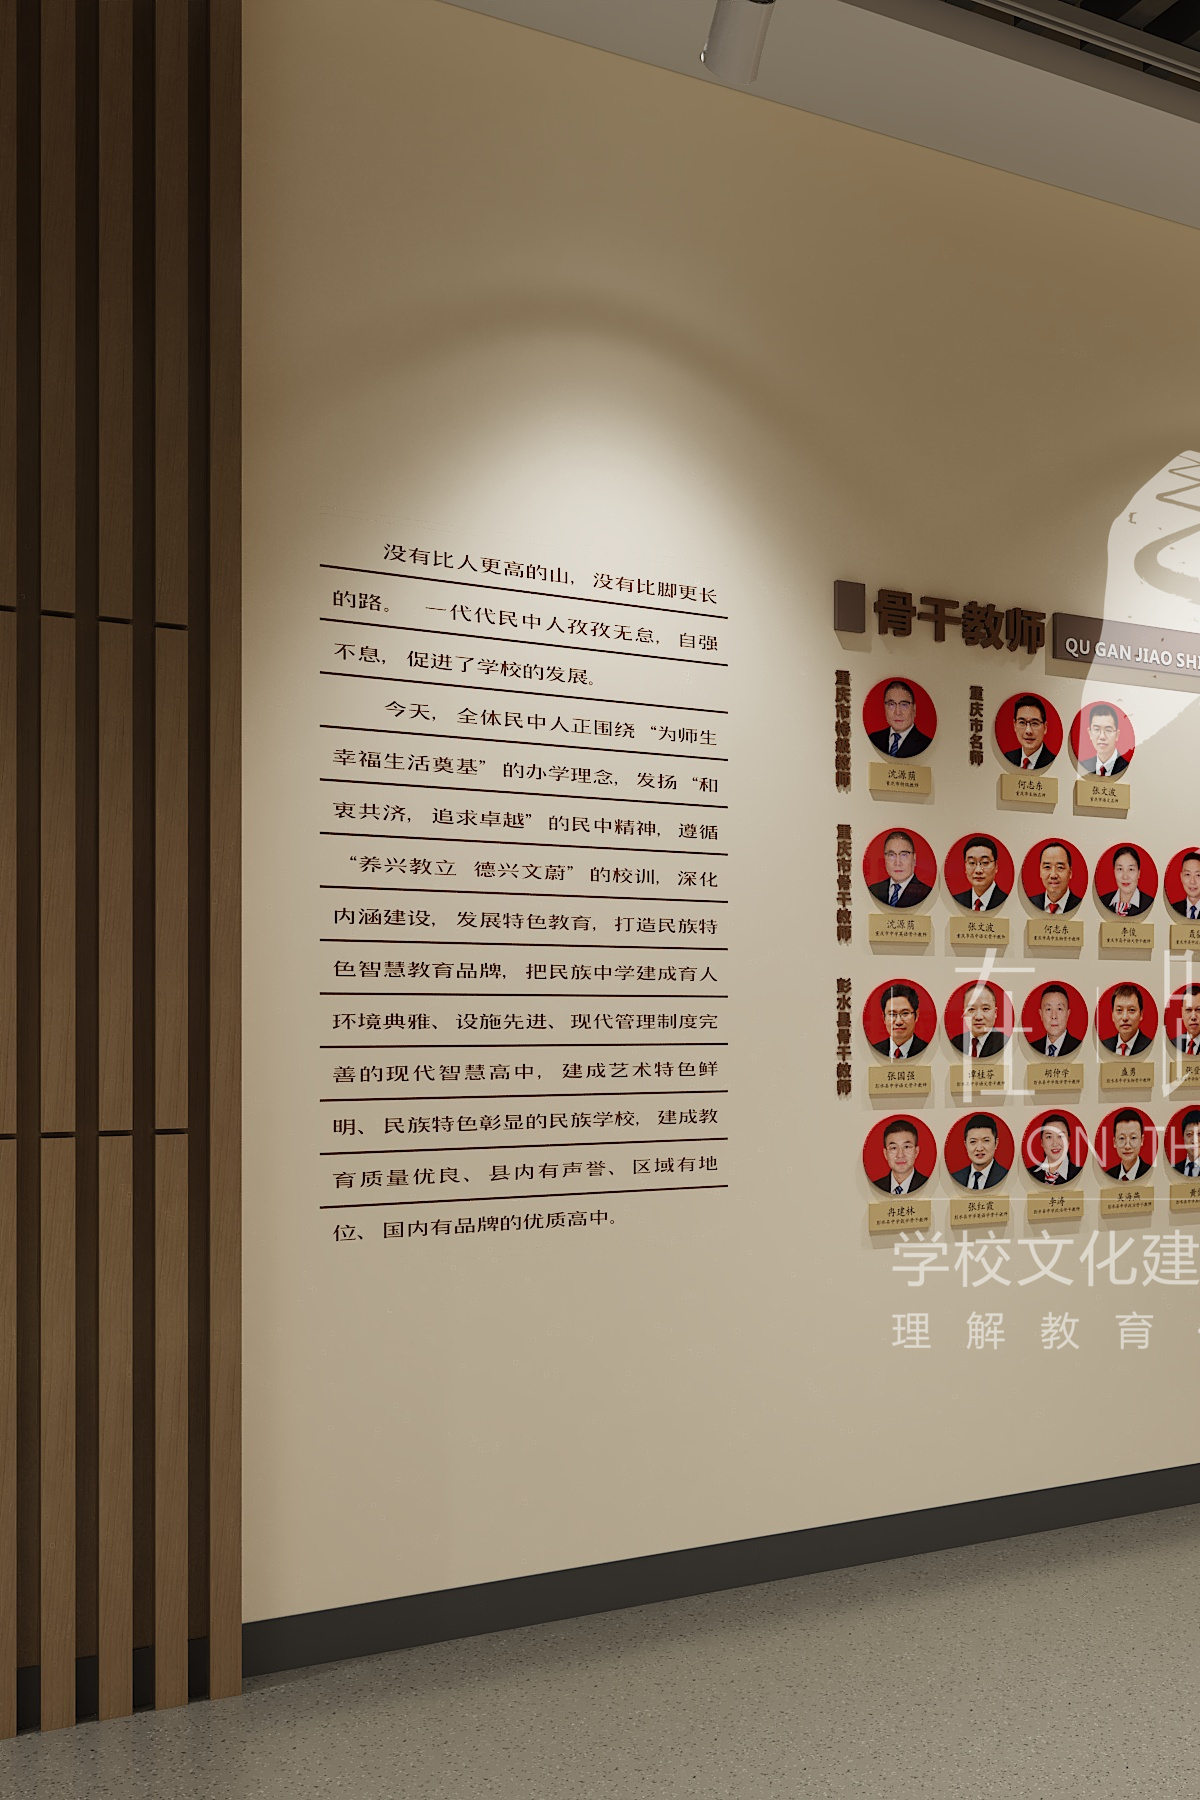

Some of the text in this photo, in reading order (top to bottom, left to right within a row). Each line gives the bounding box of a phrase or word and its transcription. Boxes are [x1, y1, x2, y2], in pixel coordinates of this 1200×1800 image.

[874, 588, 1046, 655] 骨干教师
[334, 643, 595, 687] 不息，促进了学校的发展。
[1065, 637, 1091, 658] QU
[1095, 641, 1131, 662] GAN
[1135, 647, 1172, 666] JIAO
[835, 669, 851, 788] 重庆市特级教师
[969, 685, 984, 766] 重庆市名师
[1092, 786, 1117, 797] 张文波
[836, 824, 852, 941] 重庆市骨干教师
[333, 909, 718, 935] 内涵建设，发展特色教育，打造民族特
[968, 922, 995, 932] 张文波
[333, 960, 718, 982] 色智慧教育品牌，把民族中学建成育人
[333, 1013, 718, 1030] 环境典雅、设施先进、现代管理制度完
[836, 977, 852, 1096] 彭水县骨干教师
[333, 1063, 718, 1083] 善的现代智慧高中，建成艺术特色鲜
[887, 1071, 915, 1081] 张国强
[333, 1109, 718, 1135] 明、民族特色彰显的民族学校，建成教
[333, 1156, 718, 1188] 育质量优良、县内有声誉、区域有地
[968, 1201, 995, 1212] 张红霞
[333, 1210, 616, 1241] 位、国内有品牌的优质高中。
